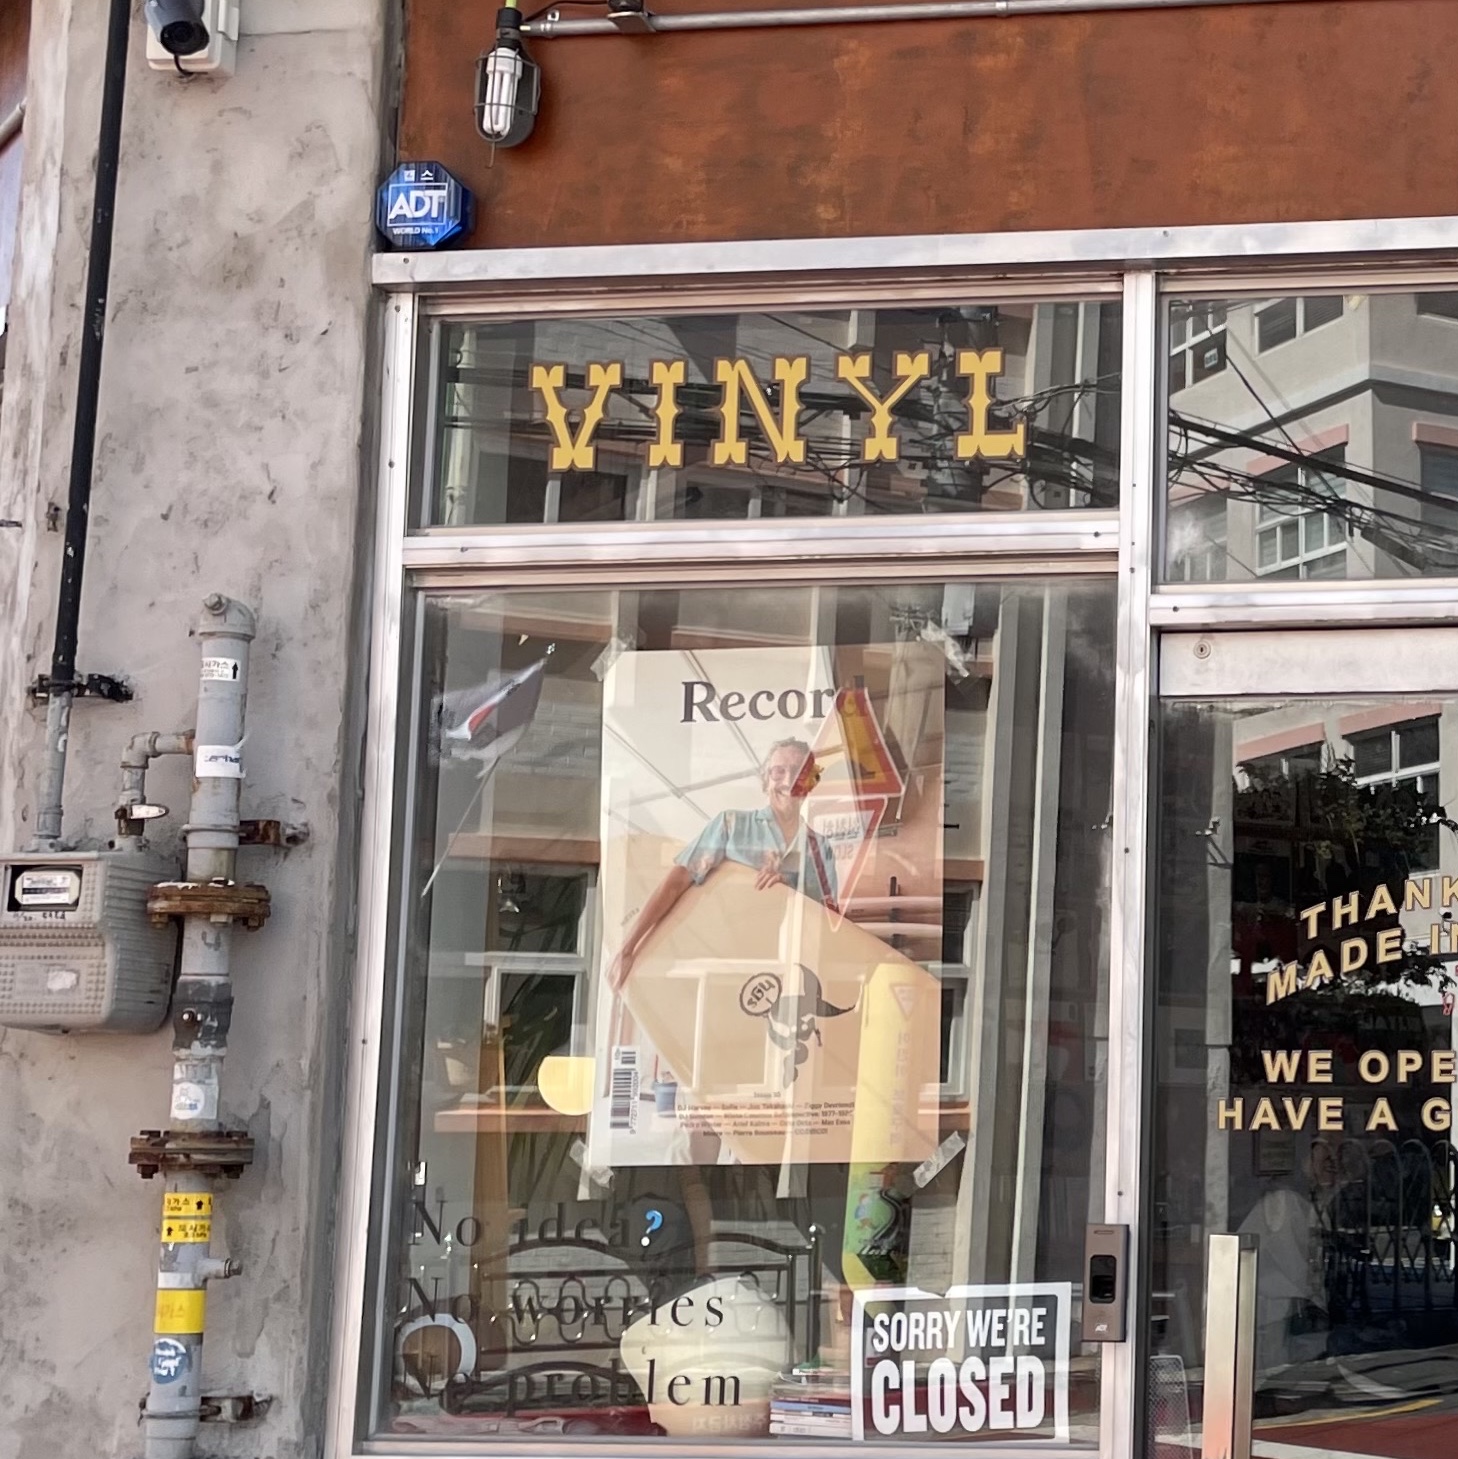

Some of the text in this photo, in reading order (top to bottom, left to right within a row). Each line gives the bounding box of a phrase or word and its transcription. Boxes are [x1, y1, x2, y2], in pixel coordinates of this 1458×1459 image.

[388, 189, 447, 219] ADT
[392, 226, 420, 234] WORLD
[527, 347, 1028, 472] VINYL
[1265, 928, 1403, 1006] MADE
[1261, 1049, 1334, 1083] WE
[1216, 1097, 1344, 1131] HAVE
[1366, 1097, 1399, 1131] A
[407, 1200, 664, 1249] No idea?
[408, 1276, 724, 1327] No worries
[872, 1307, 1047, 1353] SORRY WE'RE
[503, 1358, 742, 1417] problem
[871, 1355, 1046, 1436] CLOSED
